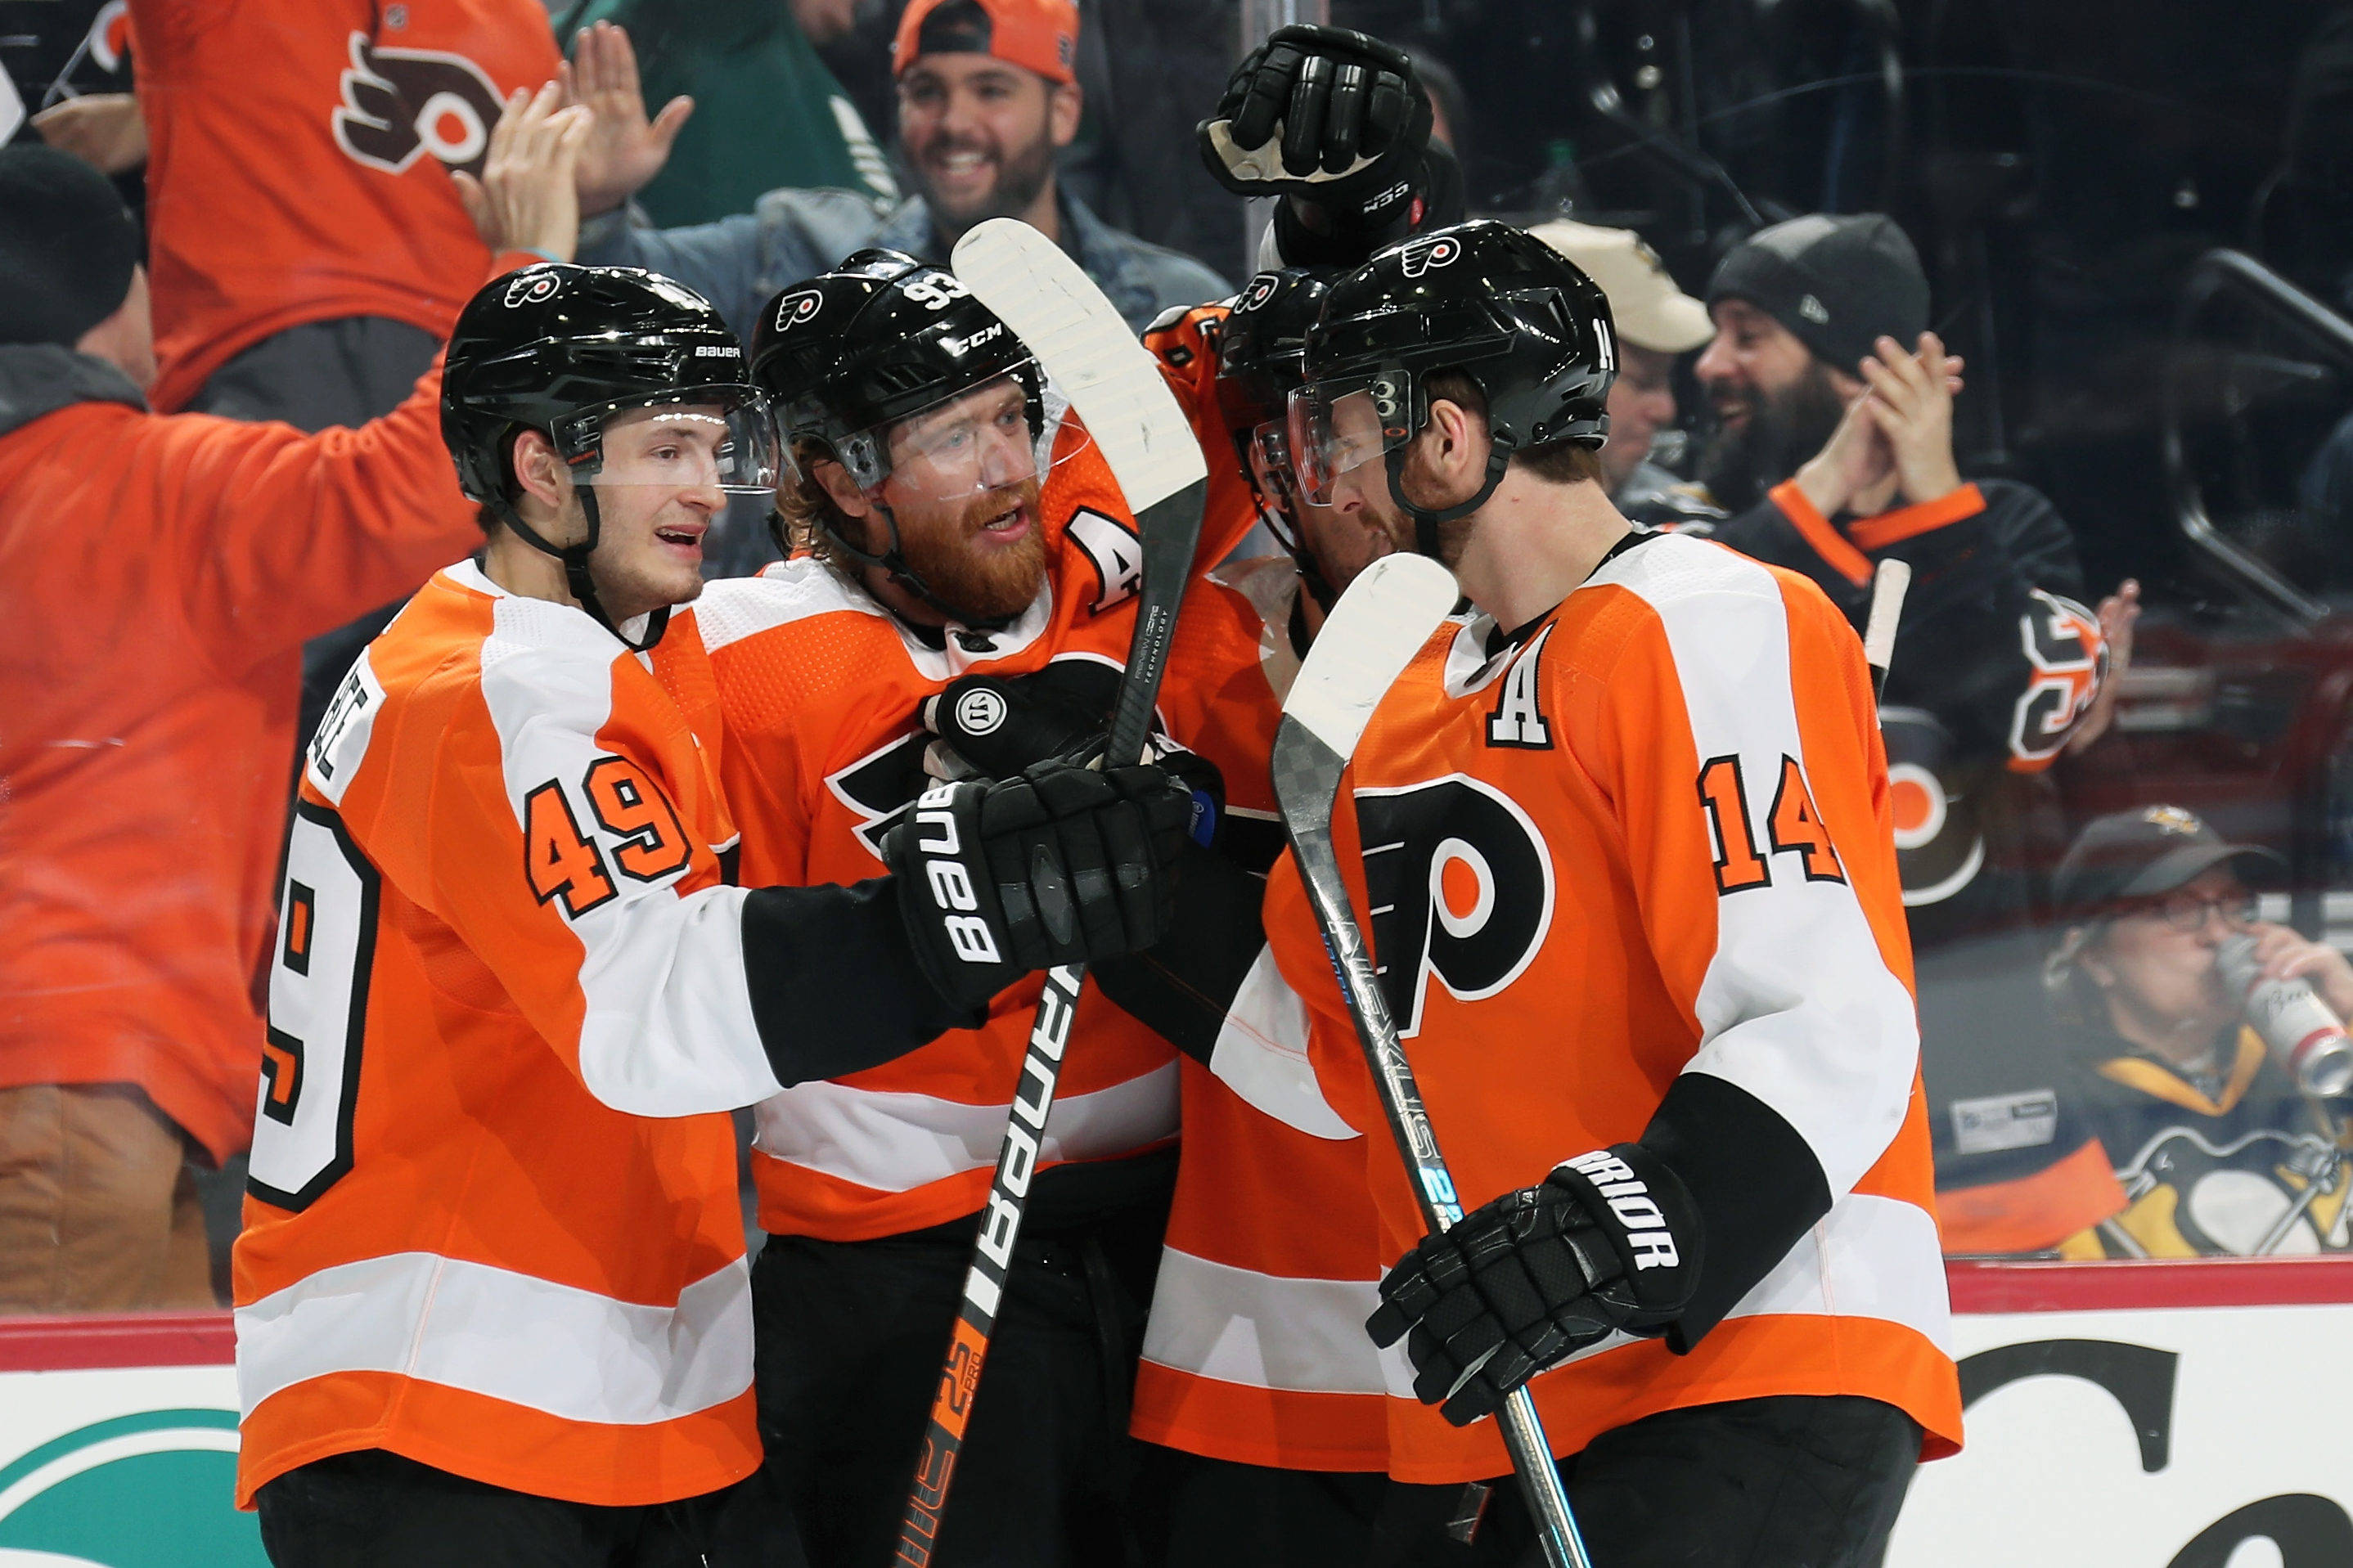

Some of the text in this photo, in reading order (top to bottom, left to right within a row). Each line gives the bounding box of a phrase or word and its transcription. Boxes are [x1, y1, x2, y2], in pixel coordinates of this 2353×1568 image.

[903, 272, 971, 310] 93
[952, 322, 1002, 357] CCM
[695, 346, 740, 358] BAUER
[1063, 505, 1143, 618] A
[1144, 609, 1168, 684] TECHNOLOGY
[1487, 618, 1559, 750] A
[524, 755, 693, 921] 49
[916, 781, 1001, 964] BAUE
[1696, 753, 1848, 896] 14
[1327, 920, 1442, 1160] NEXUS
[964, 1351, 982, 1392] PRO
